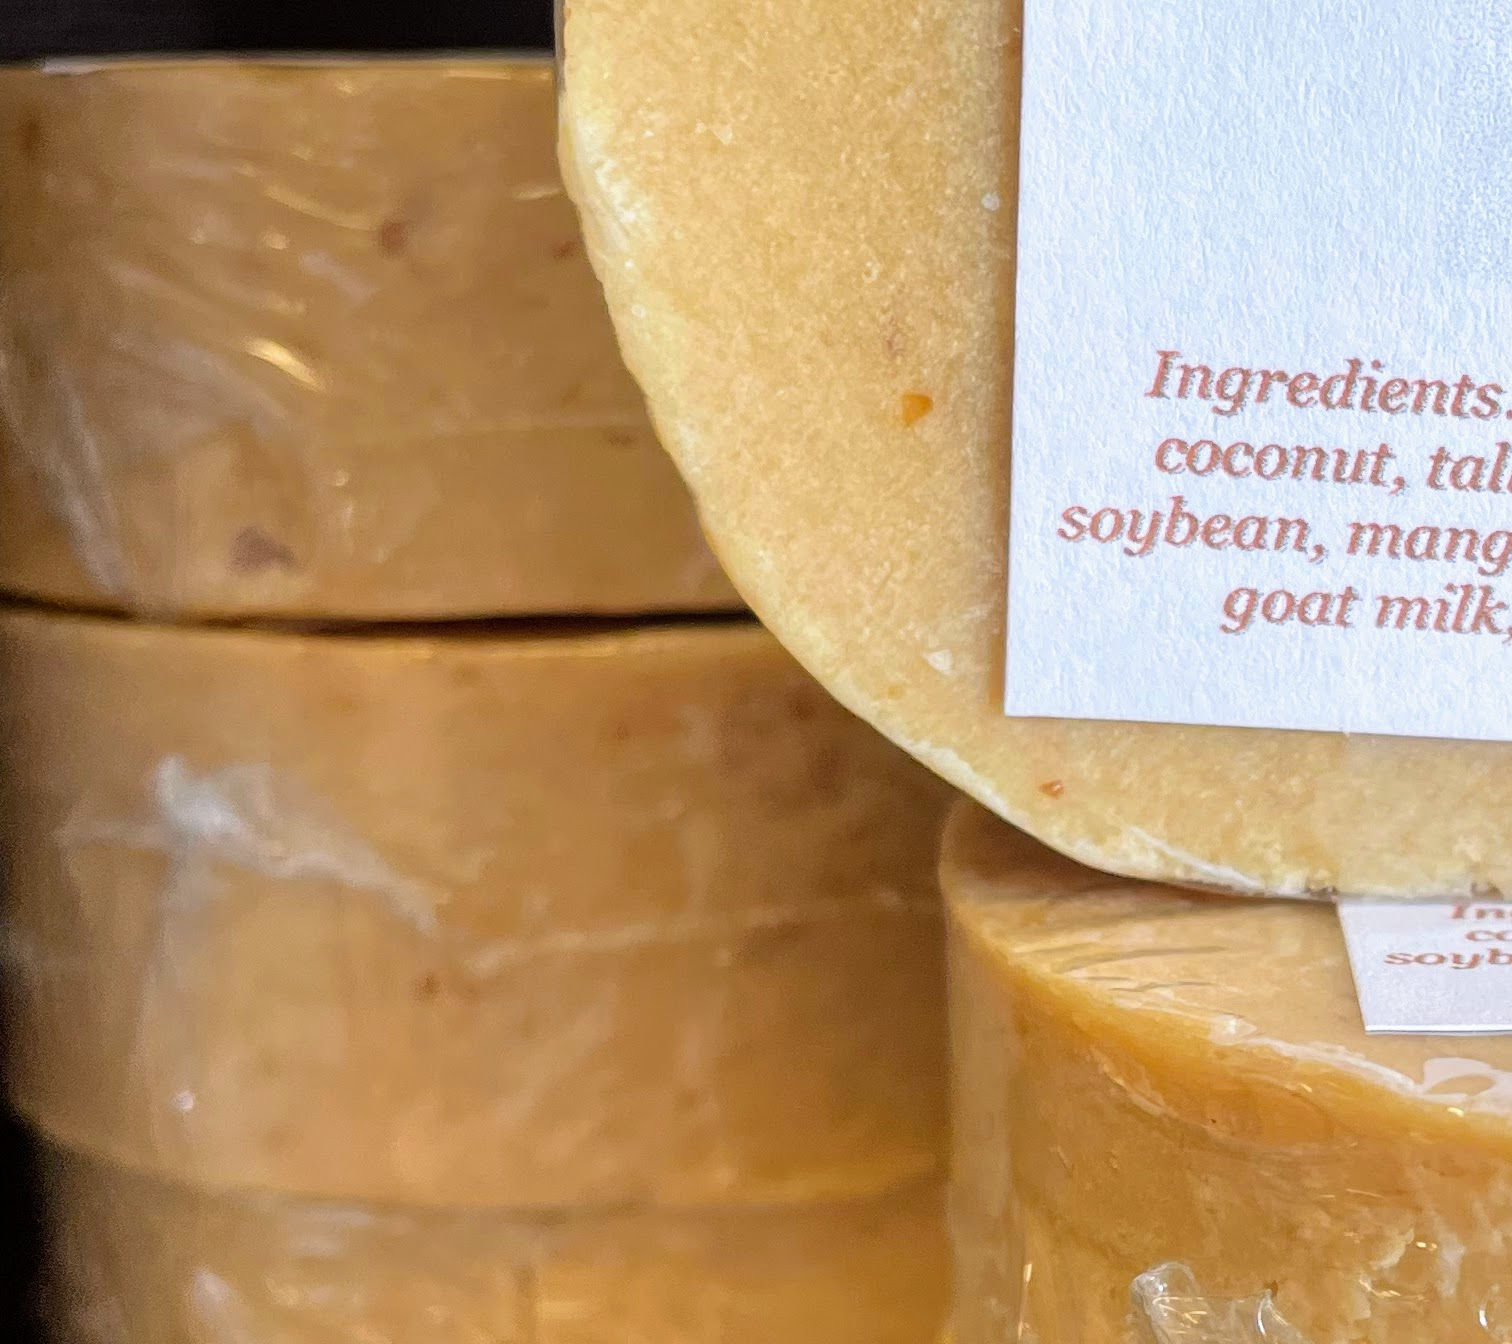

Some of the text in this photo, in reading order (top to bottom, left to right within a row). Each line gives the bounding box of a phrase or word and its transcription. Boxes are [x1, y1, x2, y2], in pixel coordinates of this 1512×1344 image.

[1153, 430, 1404, 492] coconut,
[1058, 496, 1324, 564] soybean,
[1222, 581, 1354, 635] goat
